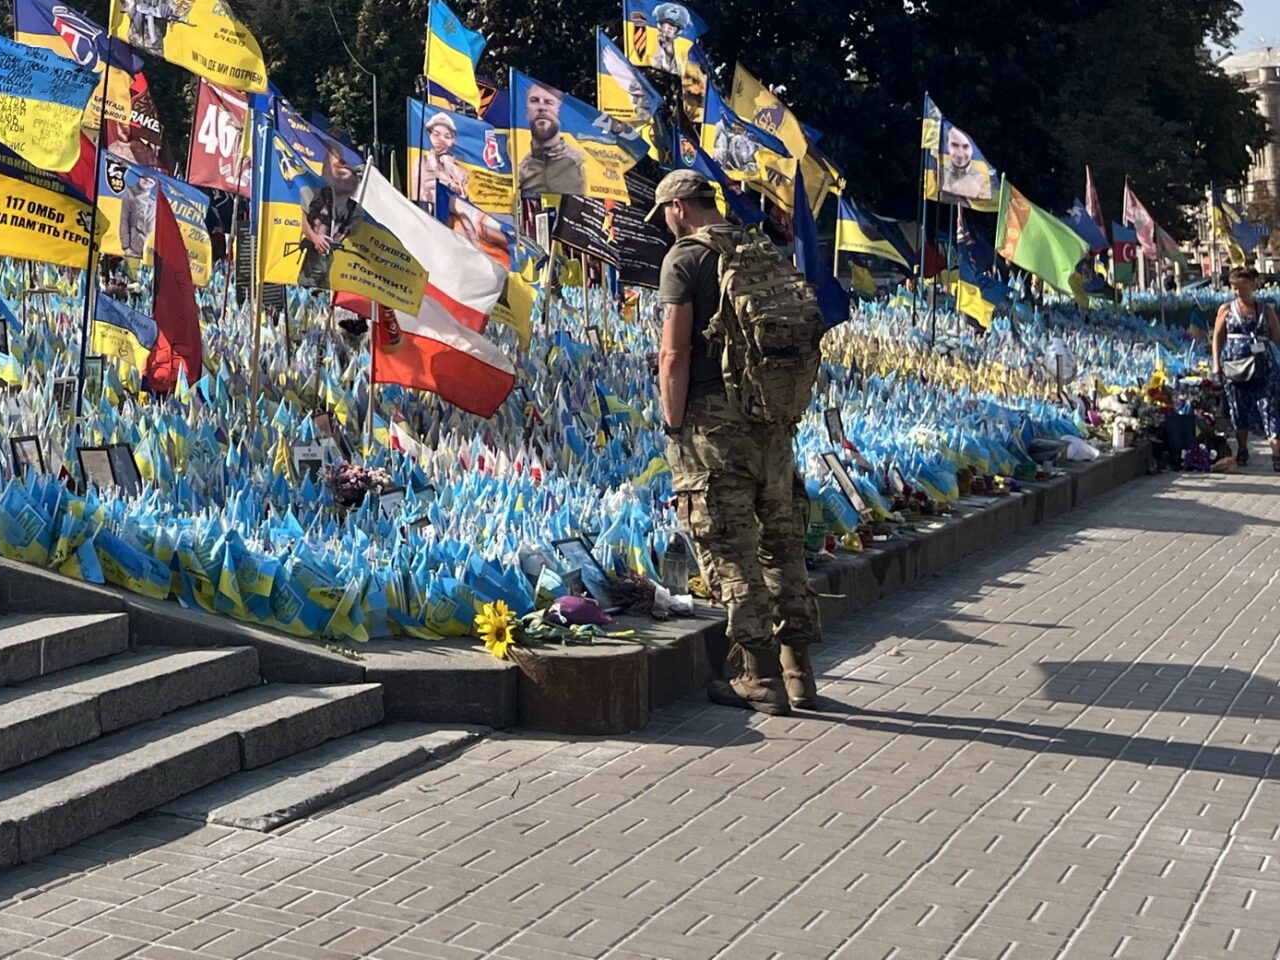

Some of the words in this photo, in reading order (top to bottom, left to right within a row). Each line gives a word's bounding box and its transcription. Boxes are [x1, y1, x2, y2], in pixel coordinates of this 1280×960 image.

[6, 194, 26, 211] 117
[27, 200, 66, 224] ОМБр
[9, 214, 61, 238] ПАМ'ЯТЬ
